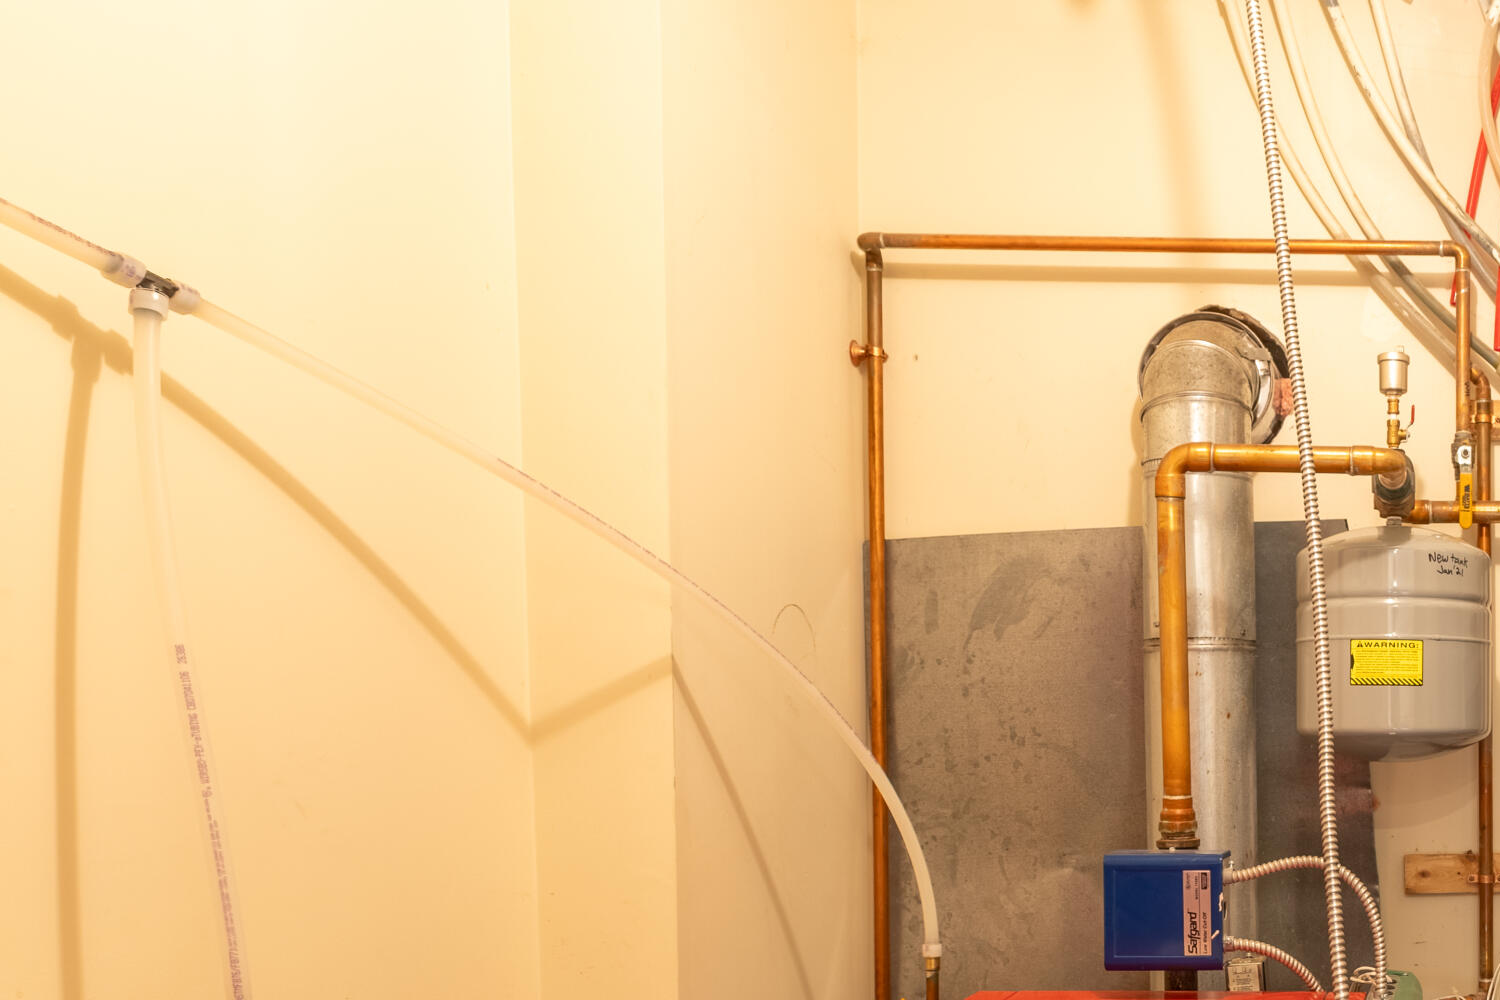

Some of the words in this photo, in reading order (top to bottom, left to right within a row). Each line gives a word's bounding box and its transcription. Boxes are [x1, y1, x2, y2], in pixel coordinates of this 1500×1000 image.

[1428, 552, 1449, 564] New
[1451, 553, 1469, 568] tank
[1437, 565, 1453, 576] Jan
[1188, 911, 1200, 954] Safgard
